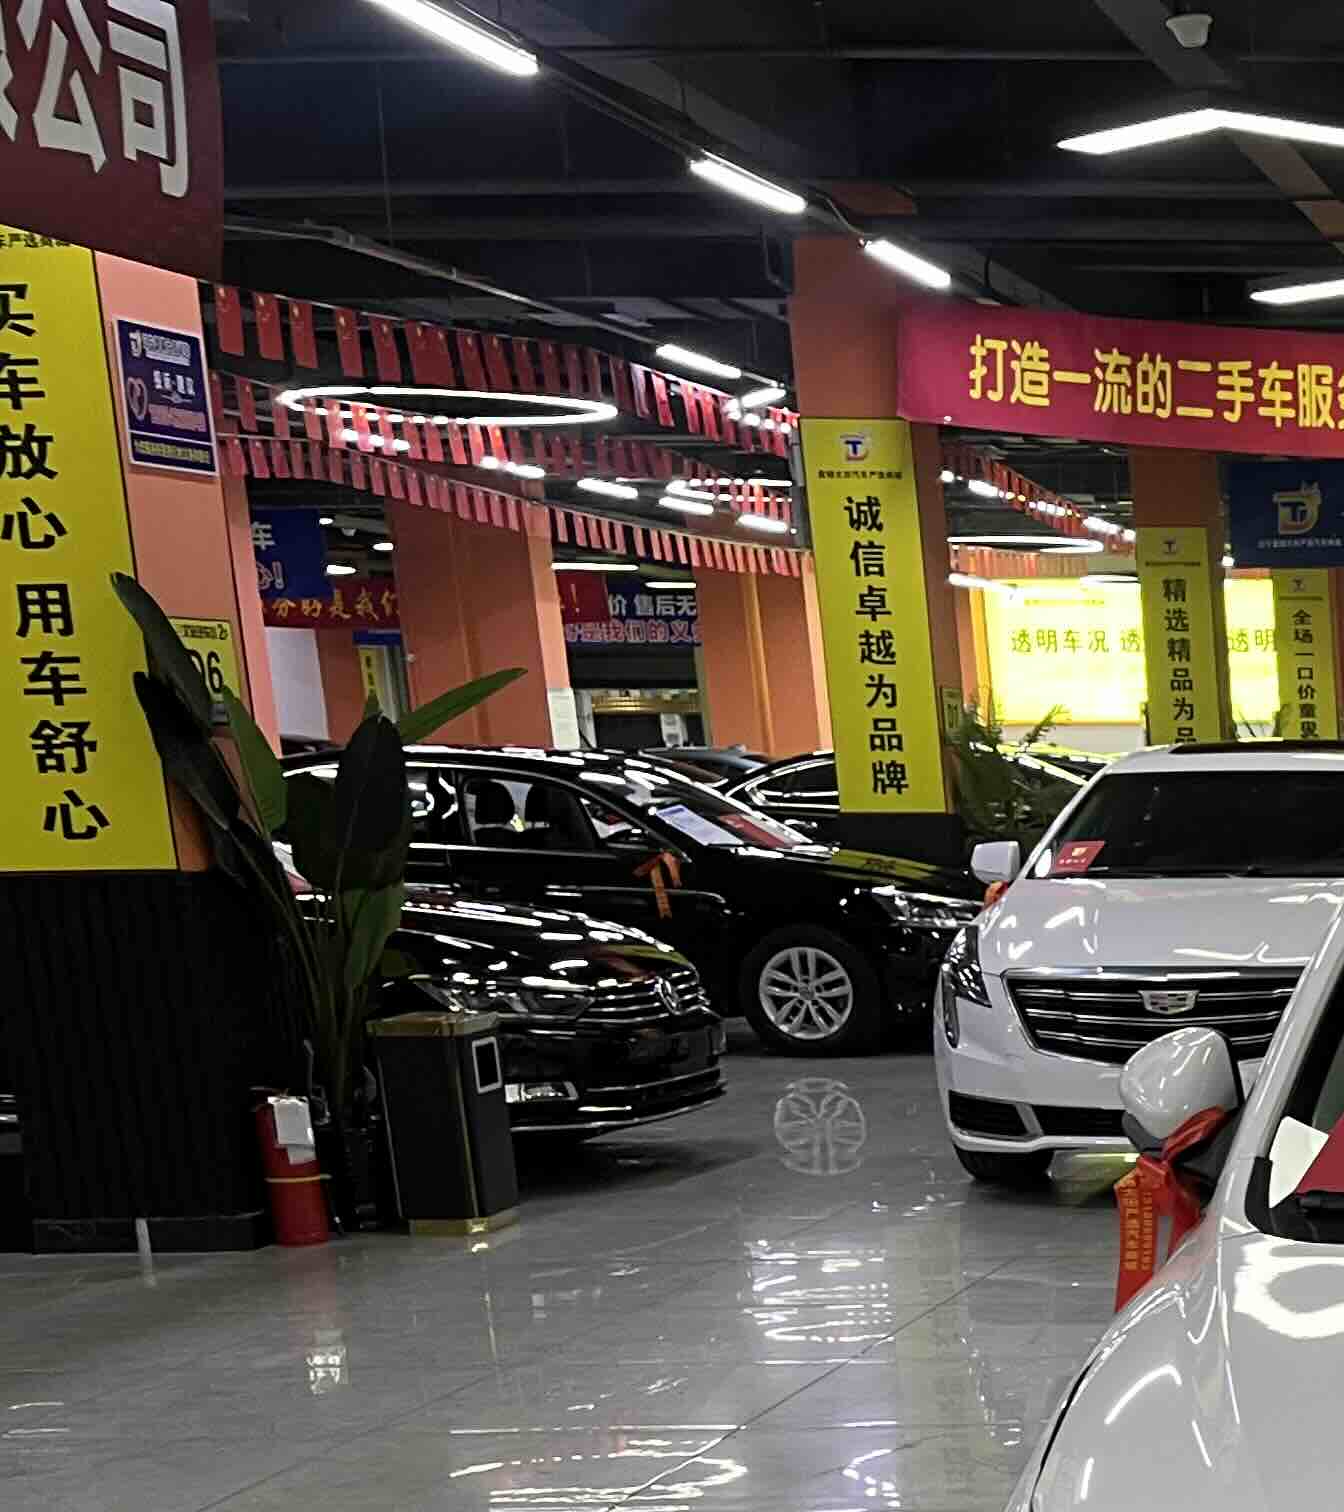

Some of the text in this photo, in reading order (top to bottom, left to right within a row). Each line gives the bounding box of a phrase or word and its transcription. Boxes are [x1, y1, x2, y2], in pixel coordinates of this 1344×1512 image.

[15, 583, 111, 841] 用车舒心
[844, 496, 909, 795] 诚信卓越为品牌
